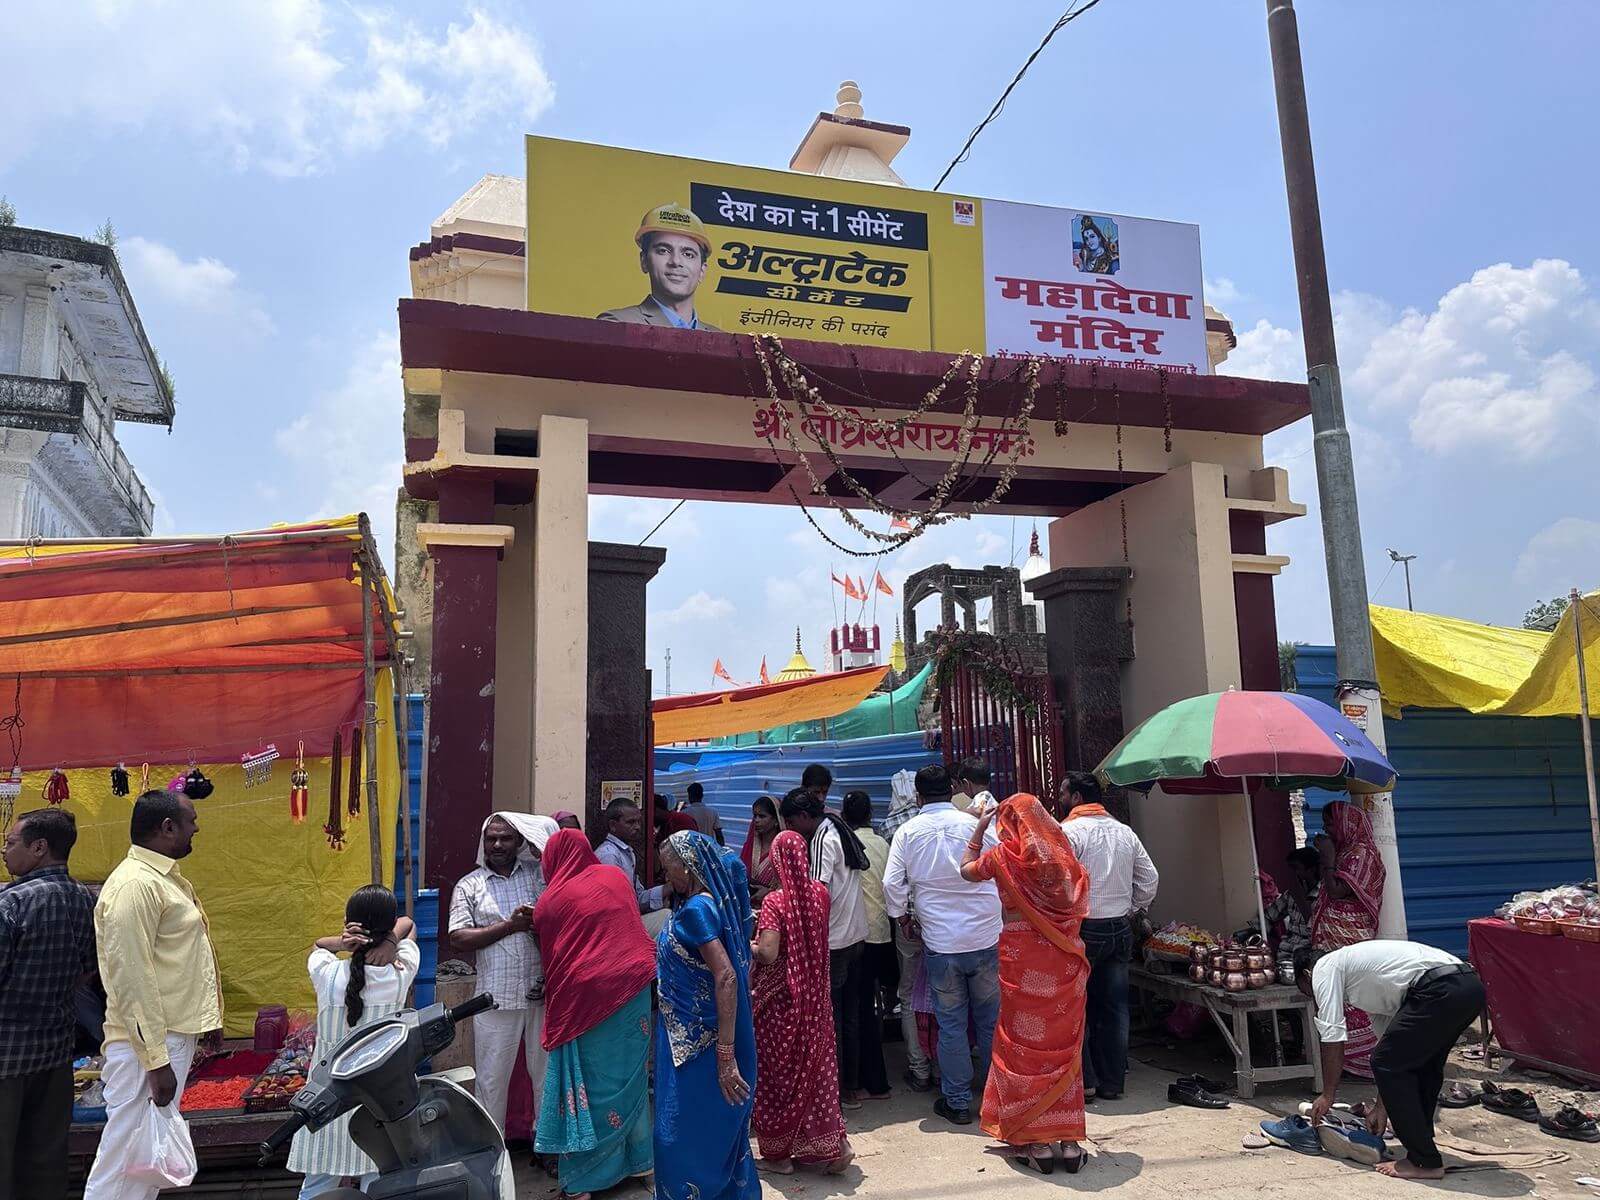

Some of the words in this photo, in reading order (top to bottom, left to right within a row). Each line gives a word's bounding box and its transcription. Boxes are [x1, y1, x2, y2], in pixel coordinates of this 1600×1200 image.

[718, 192, 757, 222] देश
[763, 205, 795, 227] का
[846, 210, 904, 241] सीमेंट
[717, 242, 909, 288] अल्ट्राटेक
[994, 276, 1193, 320] महादेवा
[739, 308, 815, 330] इंजीनियर
[822, 316, 845, 333] की
[851, 321, 890, 339] पसंद
[1030, 314, 1164, 355] मंदिर
